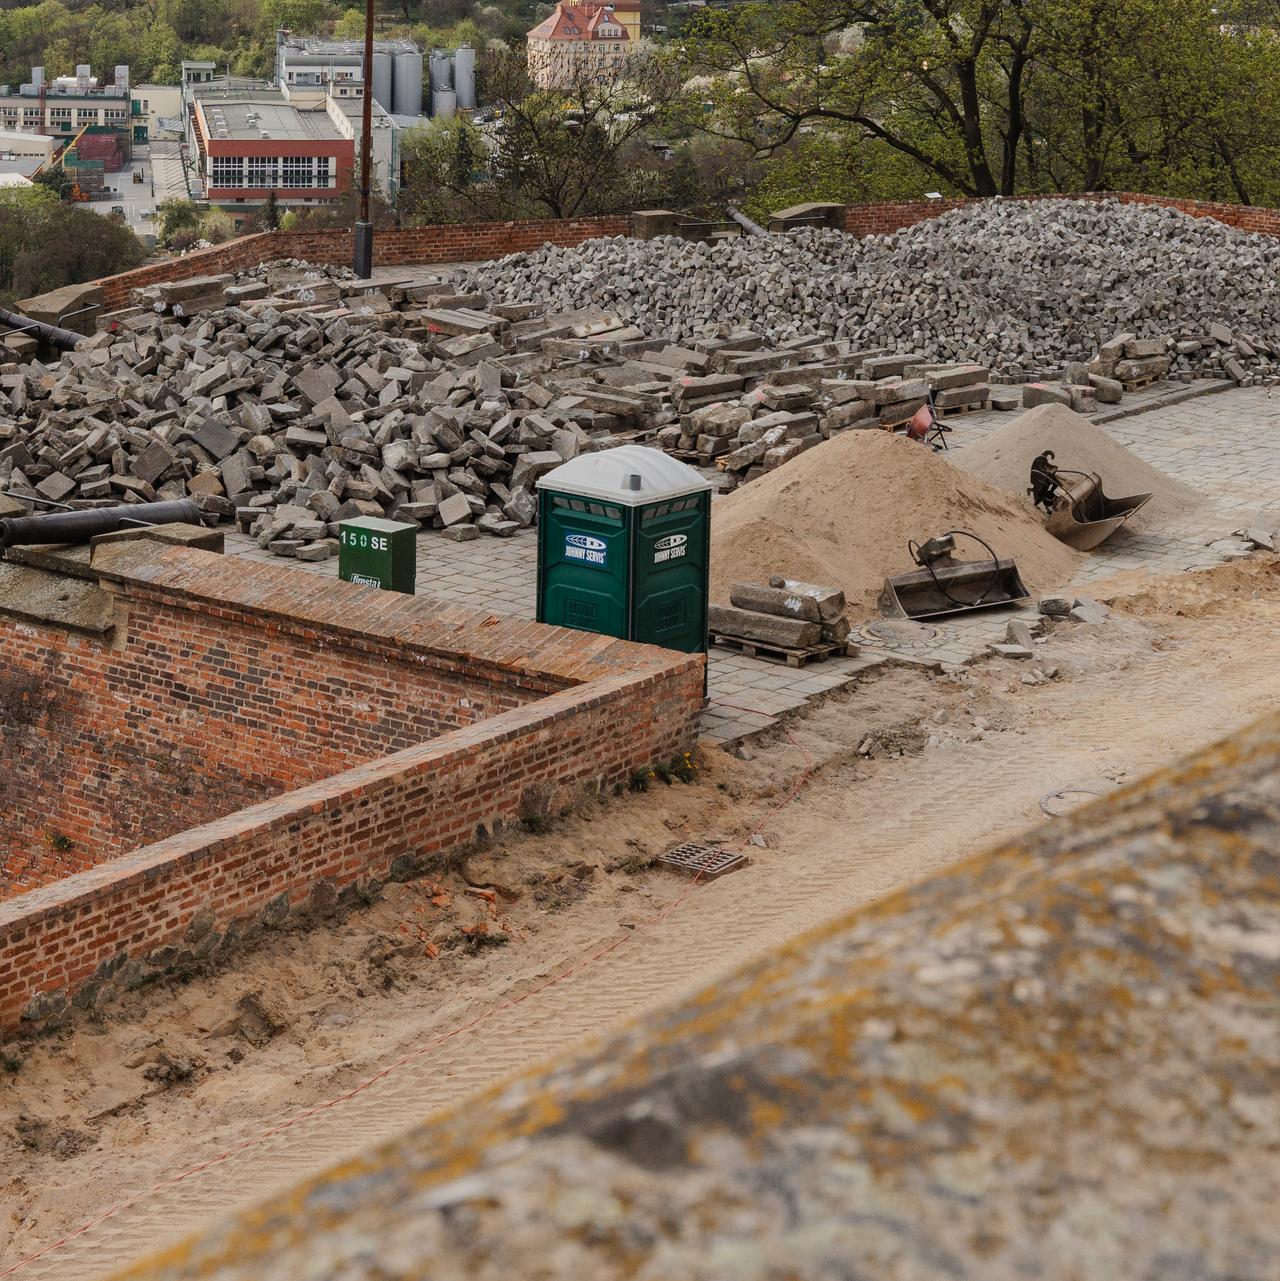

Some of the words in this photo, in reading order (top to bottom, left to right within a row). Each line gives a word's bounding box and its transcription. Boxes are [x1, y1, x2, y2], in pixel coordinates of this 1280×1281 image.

[565, 546, 585, 559] JOHNNY
[586, 549, 606, 564] SERVIS
[654, 550, 670, 563] JOHNNY
[670, 544, 687, 559] SERVIS
